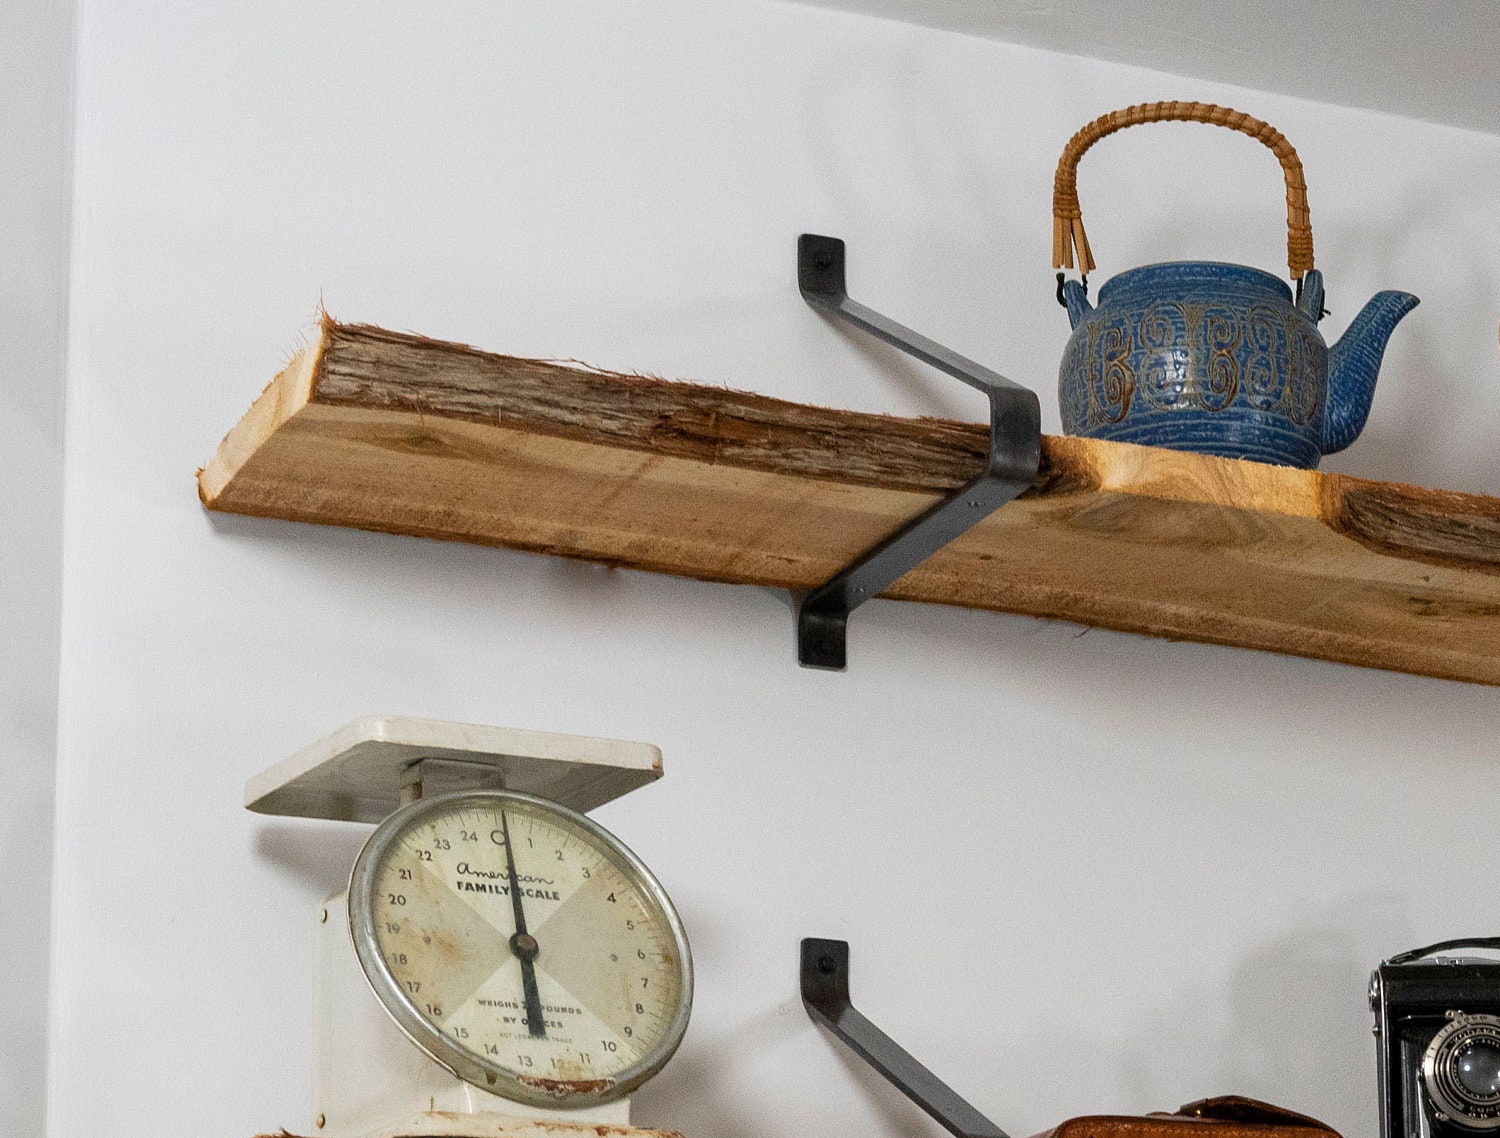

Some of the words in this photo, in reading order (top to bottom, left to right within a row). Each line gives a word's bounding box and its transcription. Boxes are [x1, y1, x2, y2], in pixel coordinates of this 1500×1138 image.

[460, 830, 478, 842] 24
[433, 838, 451, 850] 23
[527, 837, 533, 848] 1
[416, 850, 433, 861] 22
[555, 850, 564, 861] 2
[399, 868, 412, 881] 21
[457, 862, 554, 885] Amercan
[582, 867, 590, 879] 3
[456, 881, 510, 895] FAMILY
[518, 887, 560, 901] SCALE
[388, 893, 407, 906] 20
[607, 891, 616, 904] 4
[386, 922, 400, 934] 19
[626, 920, 634, 930] 5
[392, 953, 408, 965] 18
[637, 949, 645, 959] 6
[406, 981, 422, 993] 17
[641, 977, 648, 988] 7
[426, 1003, 442, 1016] 16
[636, 1003, 644, 1014] 8
[453, 1027, 469, 1039] 15
[624, 1026, 632, 1037] 9
[484, 1043, 499, 1056] 14
[601, 1040, 617, 1052] 10
[517, 1055, 533, 1067] 13
[579, 1053, 591, 1064] 11
